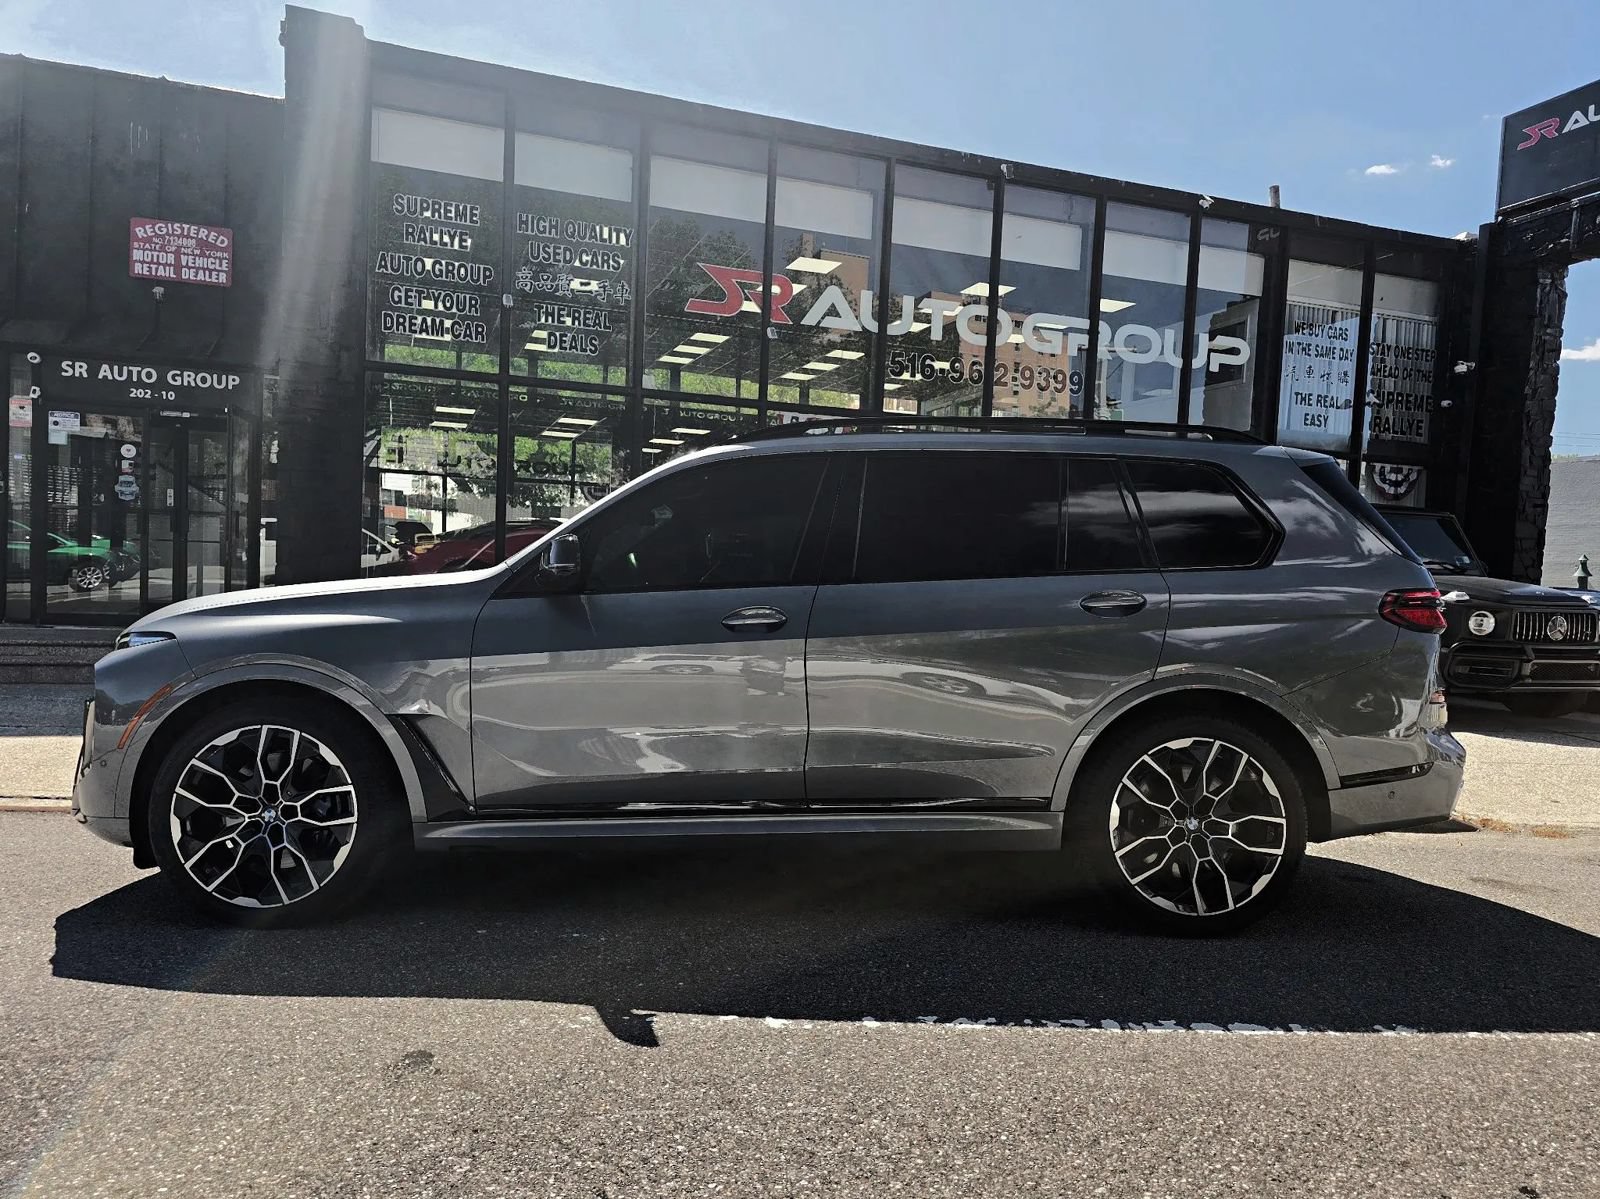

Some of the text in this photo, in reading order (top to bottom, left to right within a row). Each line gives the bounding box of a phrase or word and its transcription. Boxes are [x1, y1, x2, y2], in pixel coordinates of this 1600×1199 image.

[393, 194, 480, 226] SUPREME
[136, 223, 228, 247] REGISTERED
[404, 223, 470, 251] RALLYE
[517, 213, 634, 248] HIGH QUALITY
[133, 249, 229, 270] MOTOR VEHICLE
[134, 242, 160, 250] STATE
[205, 250, 228, 258] YORK
[529, 241, 622, 272] USED CARS
[135, 262, 226, 283] RETAIL DEALER
[376, 252, 494, 286] AUTO GROUP
[390, 285, 480, 316] GET YOUR
[382, 311, 487, 344] DREAM CAR
[534, 303, 612, 332] THE REAL
[547, 331, 599, 355] DEALS
[1294, 320, 1349, 342] WE BUY CARS
[1285, 340, 1354, 362] IN THE SAME DAY
[1370, 342, 1436, 362] STAY ONE STEP
[60, 360, 240, 390] SR AUTO GROUP
[1371, 364, 1432, 384] AHEAD OF THE
[1294, 392, 1340, 410] THE REAL
[1304, 413, 1328, 428] EASY
[1373, 416, 1424, 438] RALLYE
